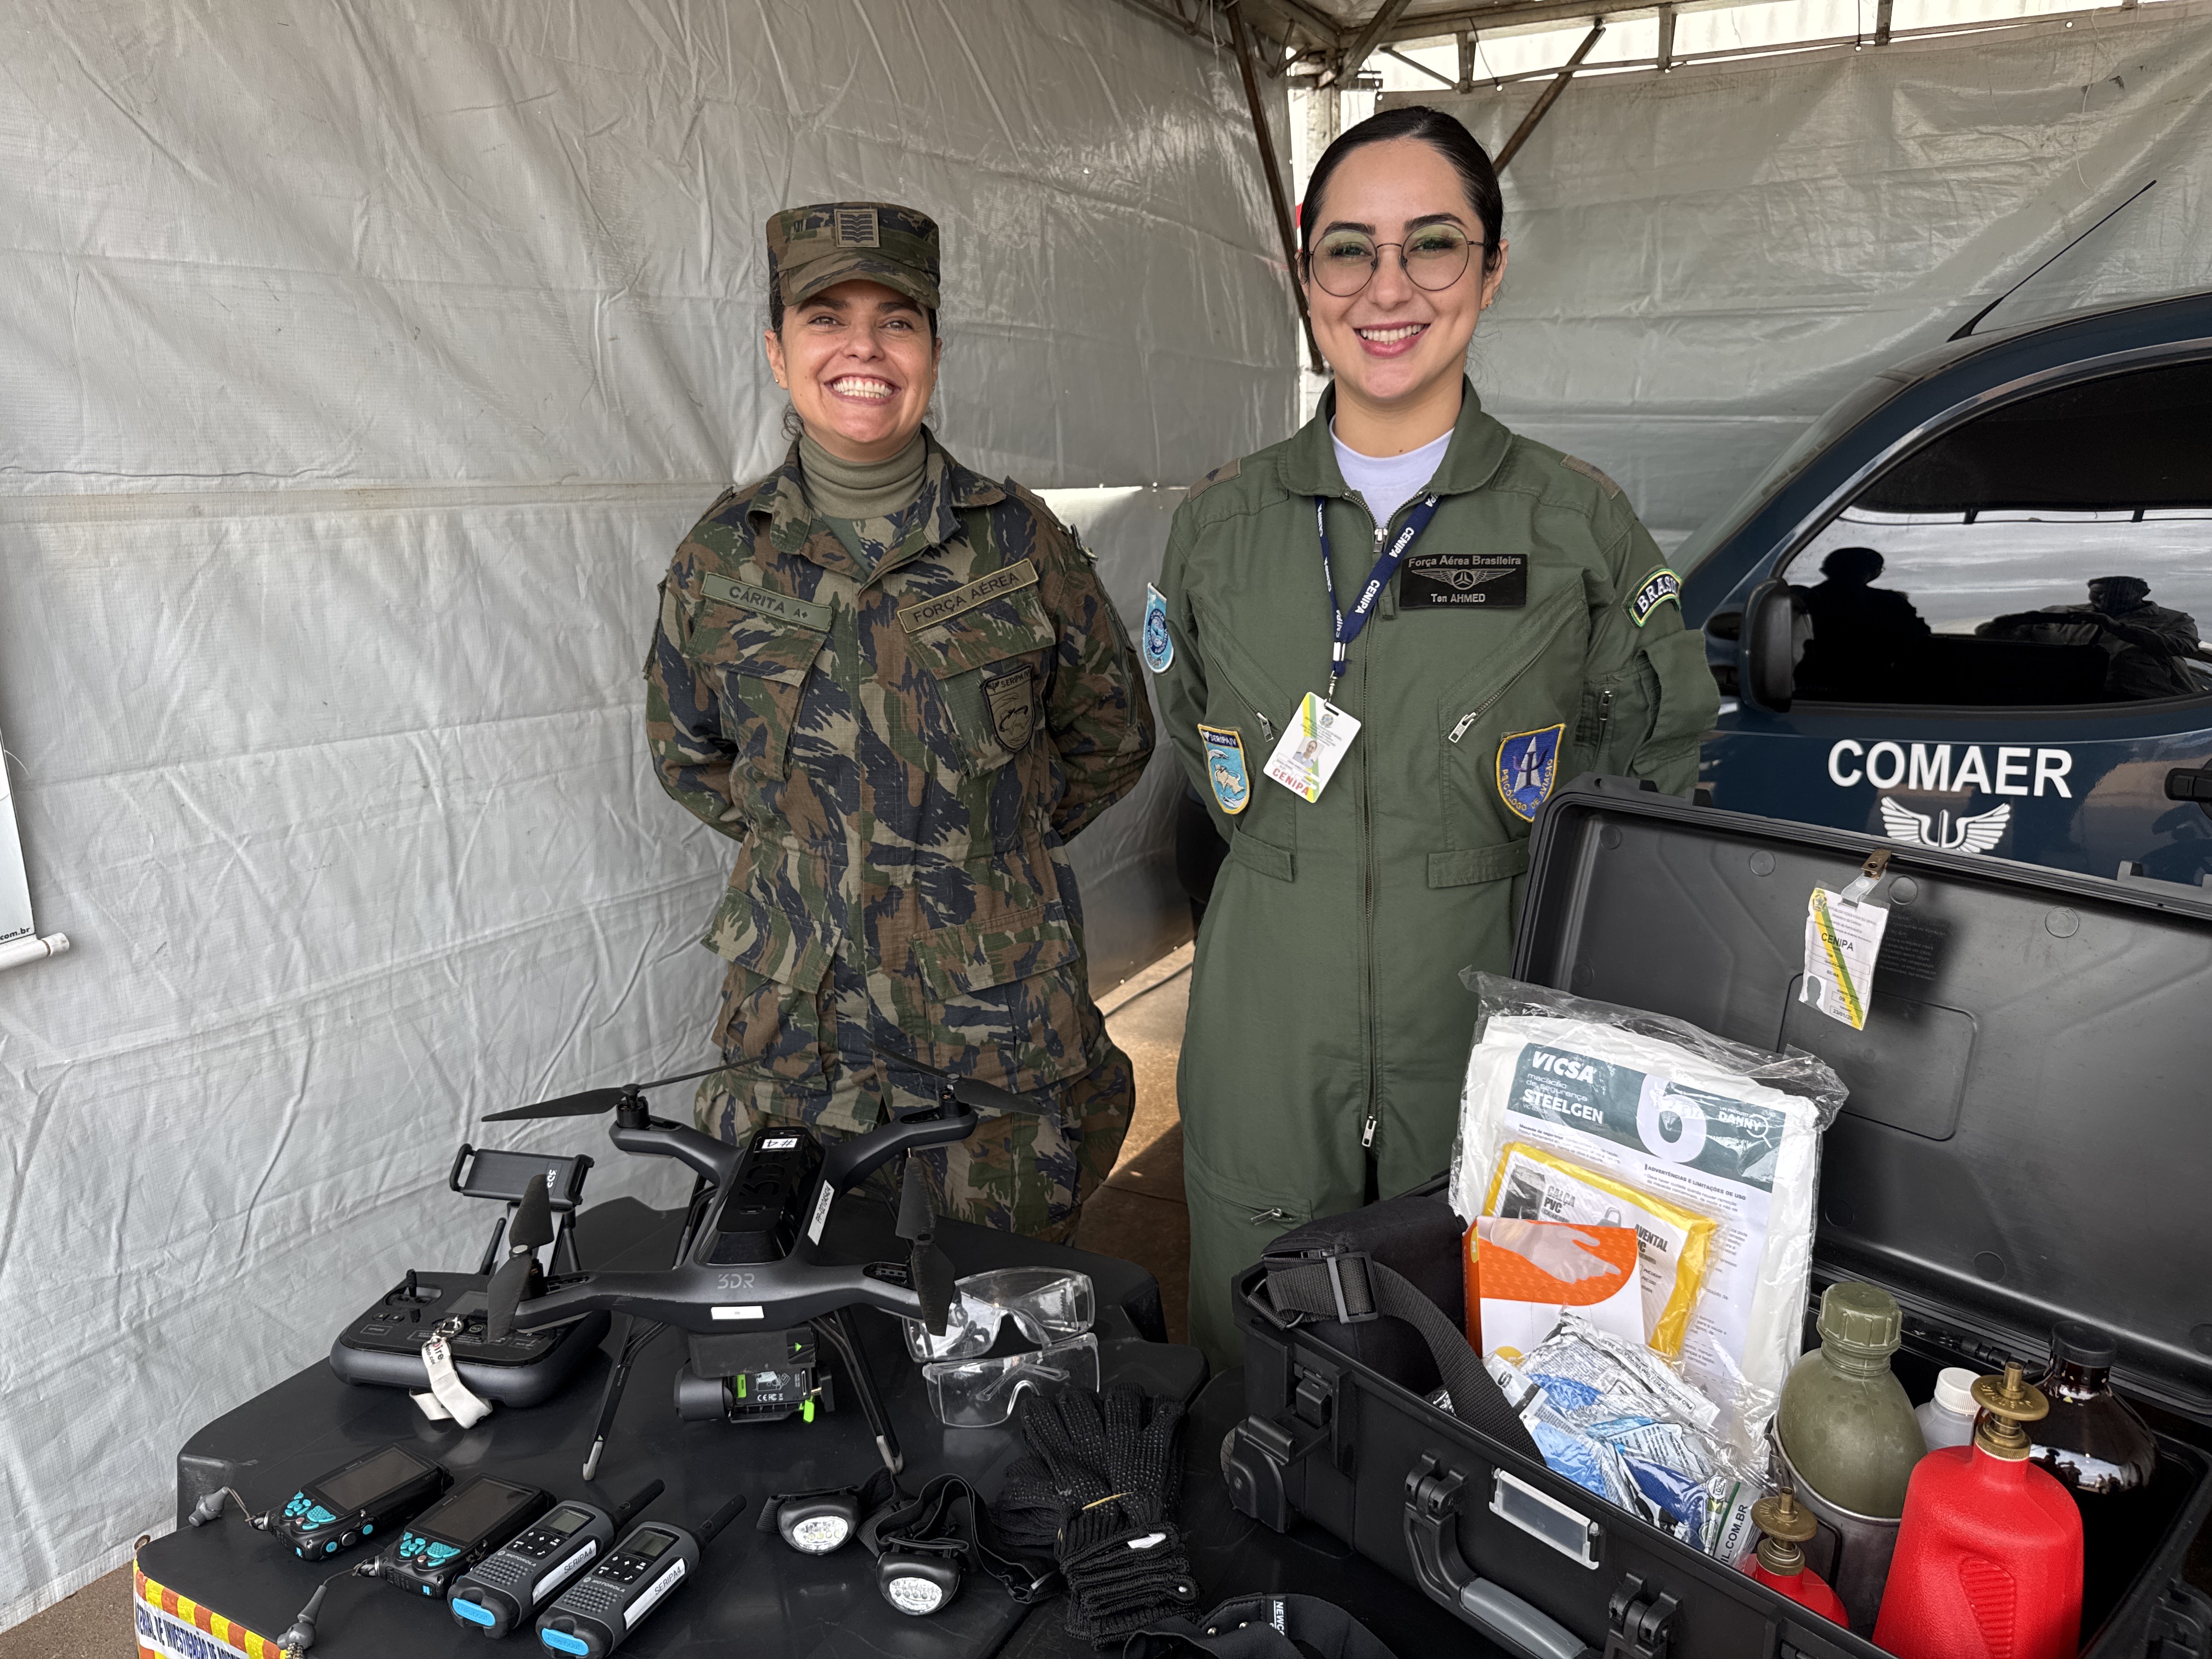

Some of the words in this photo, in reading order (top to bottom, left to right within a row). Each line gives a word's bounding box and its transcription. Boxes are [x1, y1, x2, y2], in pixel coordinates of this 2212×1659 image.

[1389, 526, 1415, 558] CENIPA
[1408, 557, 1437, 568] Força
[1438, 555, 1470, 566] Aérea
[1472, 555, 1521, 566] Brasileira
[729, 585, 785, 614] CÁRITA
[793, 608, 809, 619] A+
[912, 595, 967, 623] FORÇA
[970, 572, 1020, 600] AÉREA
[1355, 579, 1381, 614] CENIPA
[1430, 593, 1447, 603] Ten
[1450, 593, 1486, 603] AHMED
[1637, 575, 1679, 613] BRASIL
[1001, 673, 1024, 688] SERIPA
[1827, 739, 2074, 799] COMAER
[1272, 768, 1309, 796] CENIPA
[1821, 933, 1854, 951] CENIPA
[1532, 1051, 1595, 1084] VICSA
[1526, 1079, 1537, 1087] de
[1539, 1083, 1588, 1102] segurança
[1527, 1073, 1567, 1089] macacão
[1522, 1088, 1604, 1124] STEELGEN
[1718, 1110, 1762, 1131] DANNY
[1647, 1165, 1688, 1182] ADVERTÊNCIAS
[1543, 1197, 1563, 1214] PVC
[1547, 1185, 1576, 1208] CALÇA
[1635, 1223, 1668, 1253] AVENTAL
[717, 1273, 755, 1289] 3DR
[1497, 1370, 1513, 1389] S
[1667, 1389, 1683, 1402] AGRO
[1681, 1399, 1693, 1410] PRO
[1714, 1477, 1725, 1497] 100%
[1720, 1504, 1748, 1563] IL.COM.BR
[505, 1553, 537, 1567] MOTOROLA
[563, 1547, 592, 1575] SERIPA4
[591, 1579, 626, 1593] MOTOROLA
[654, 1566, 681, 1596] SERIPA4
